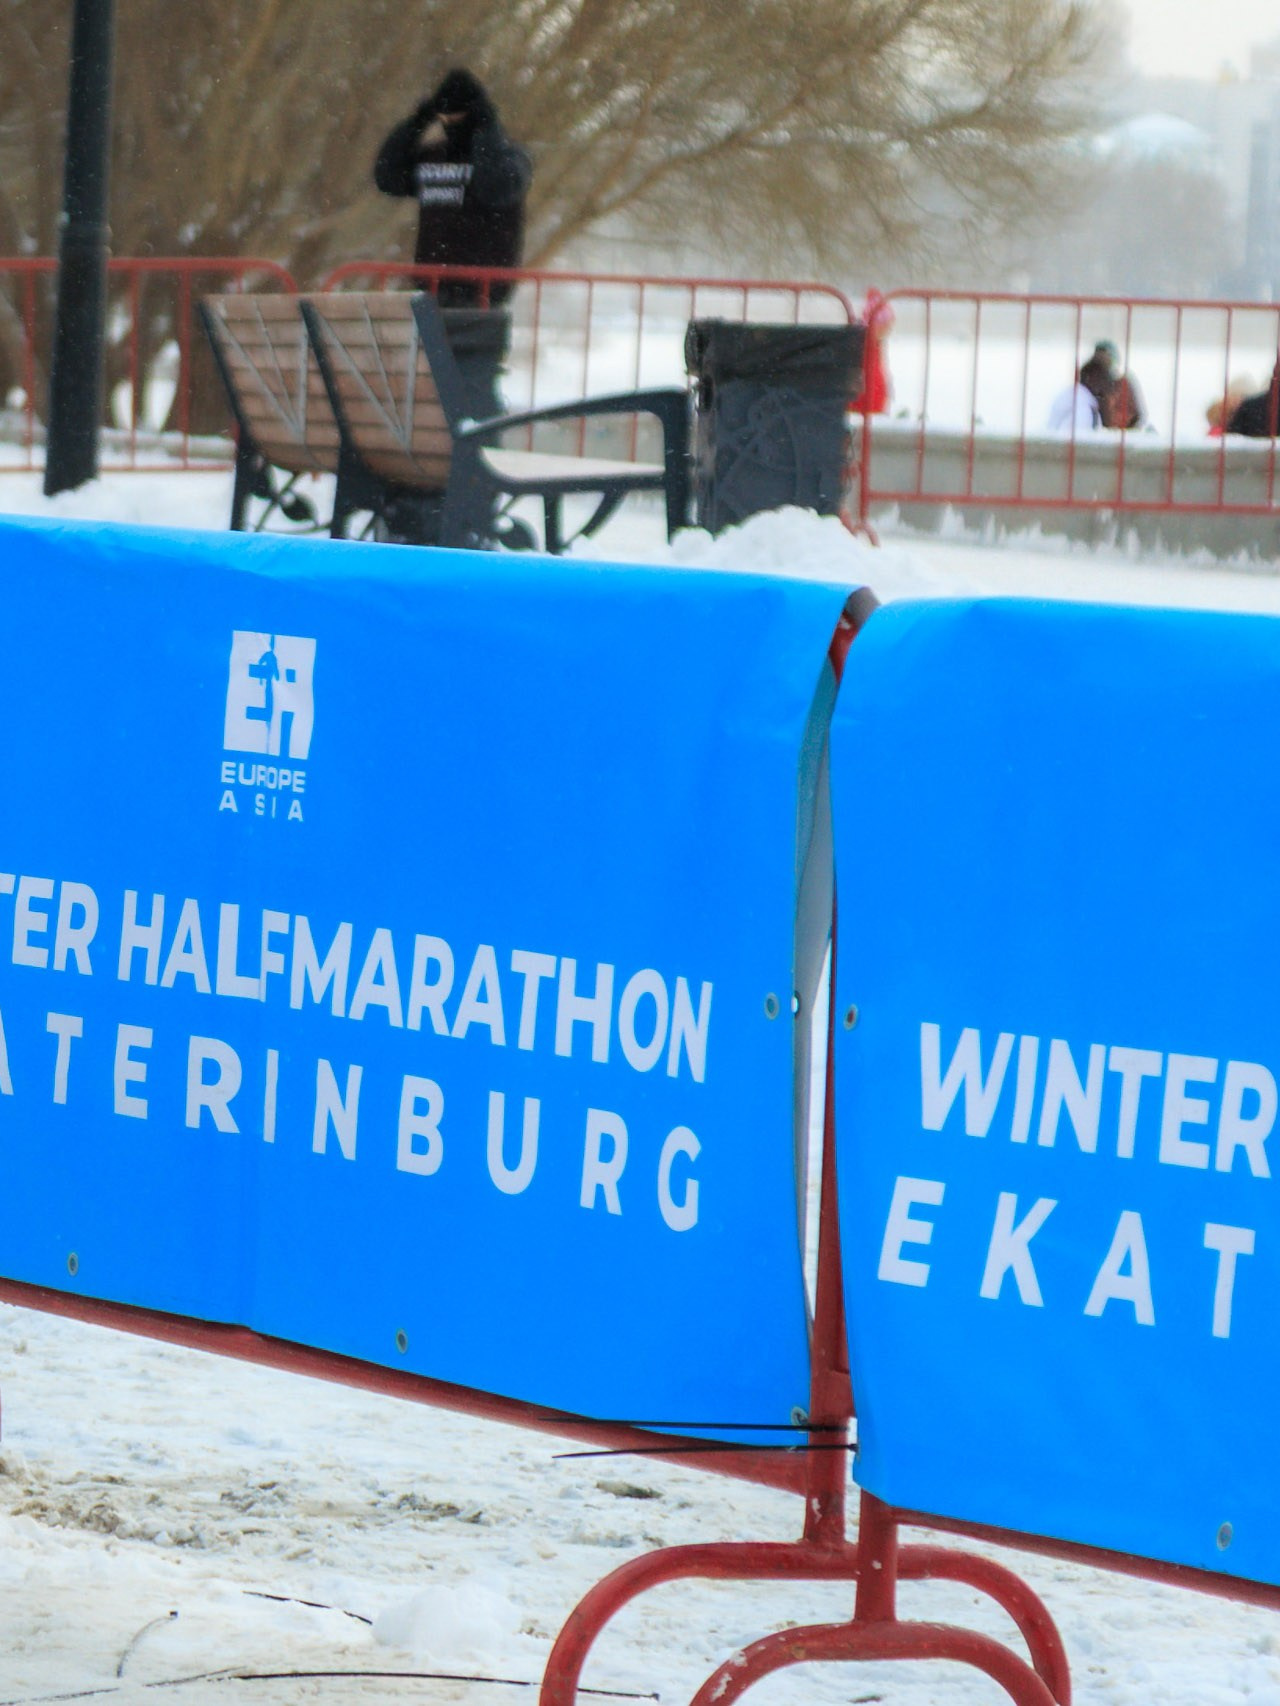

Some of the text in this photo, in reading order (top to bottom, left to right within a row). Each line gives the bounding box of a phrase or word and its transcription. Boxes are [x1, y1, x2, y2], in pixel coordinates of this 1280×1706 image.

[218, 790, 304, 822] ASIA
[220, 761, 306, 793] EUROPE
[117, 889, 714, 1084] HALFMARATHON
[920, 1022, 1278, 1179] WINTER
